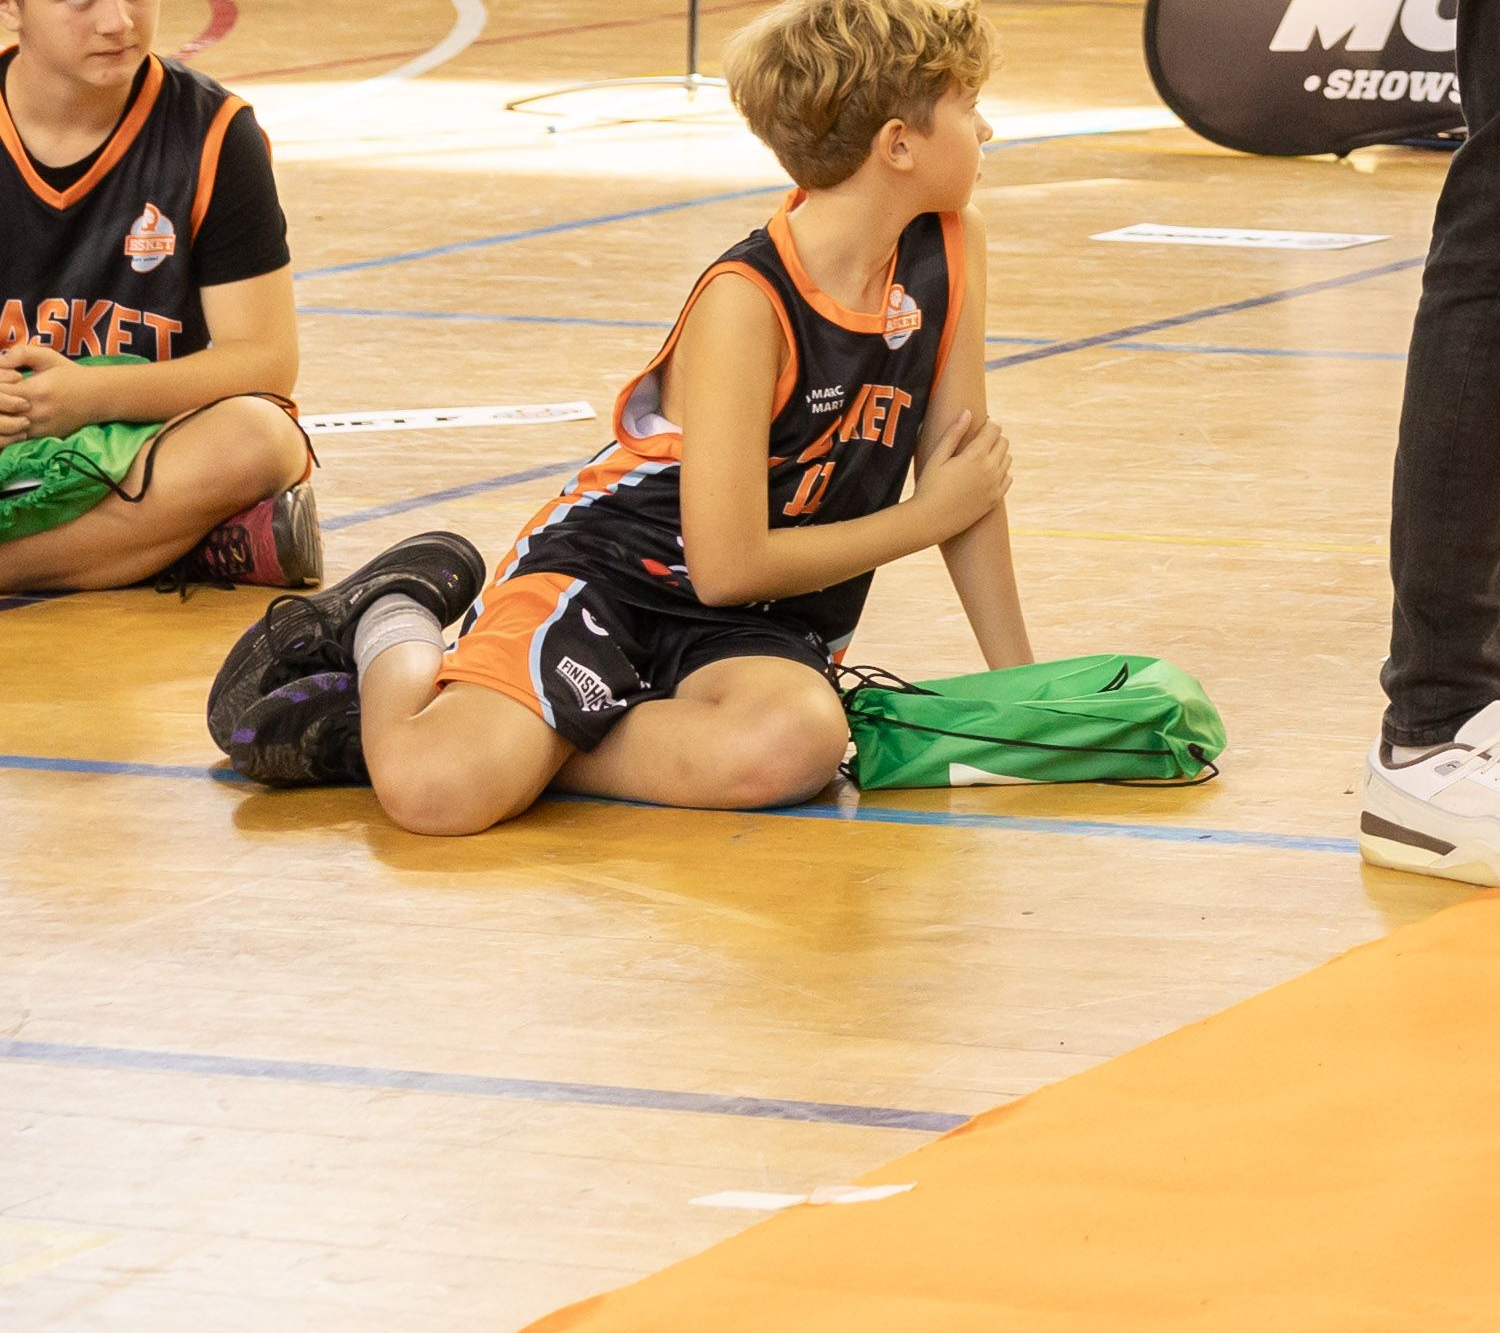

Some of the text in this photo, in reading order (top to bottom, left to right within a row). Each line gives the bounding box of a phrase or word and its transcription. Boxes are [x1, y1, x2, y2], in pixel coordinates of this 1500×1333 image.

[811, 384, 845, 400] MARC
[811, 399, 845, 415] MART
[560, 659, 613, 711] FINISH
